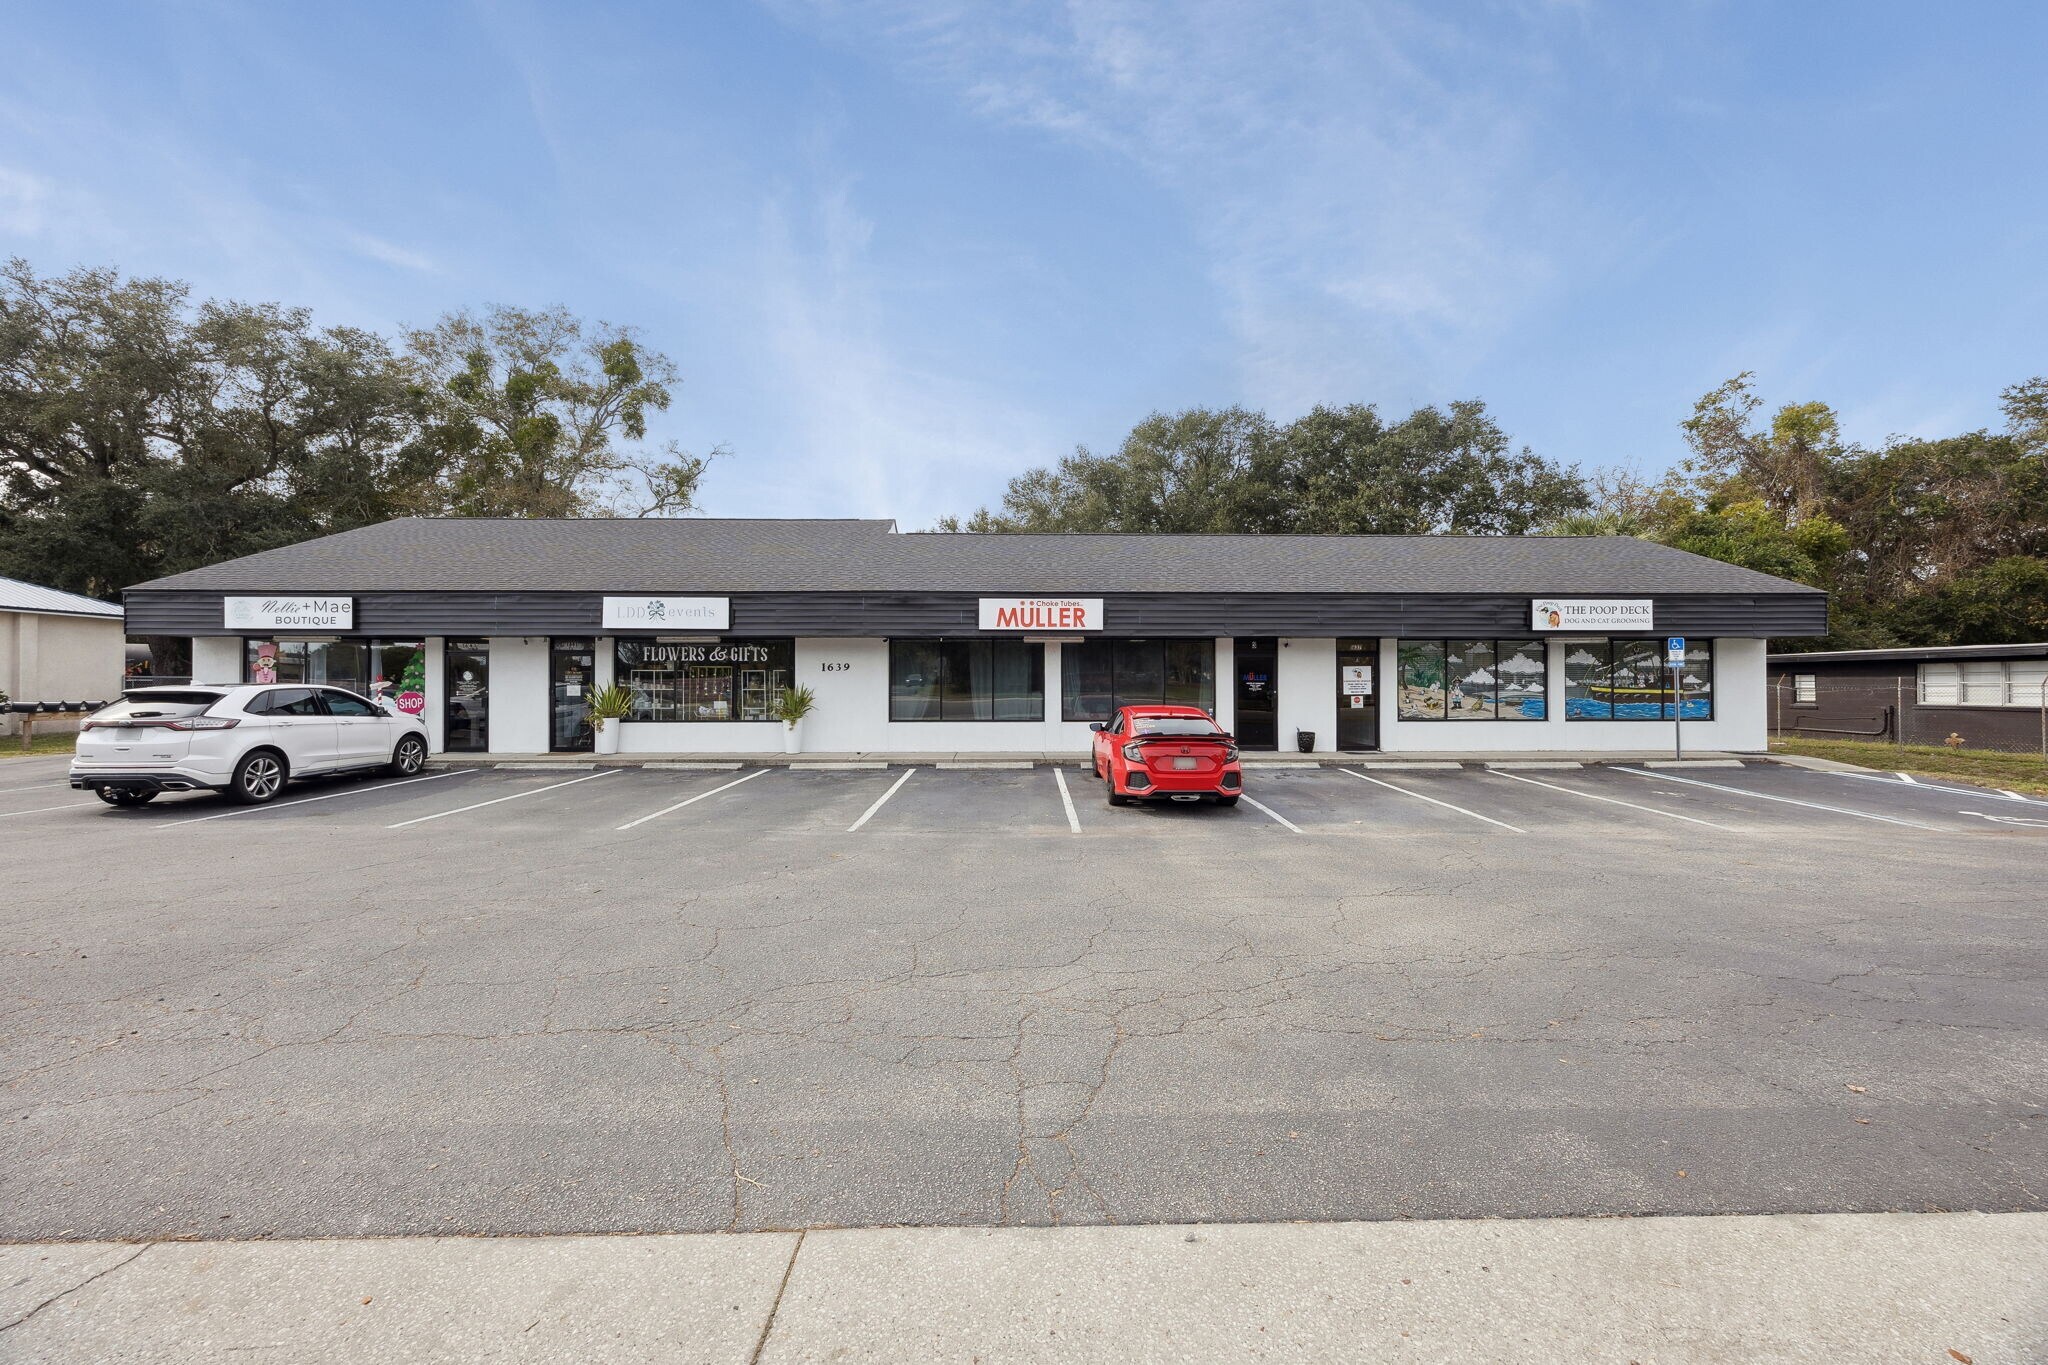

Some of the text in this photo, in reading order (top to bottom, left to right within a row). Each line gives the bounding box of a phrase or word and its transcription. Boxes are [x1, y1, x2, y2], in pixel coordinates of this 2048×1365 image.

[261, 600, 301, 613] Nellie
[314, 600, 351, 613] Mae
[668, 606, 716, 617] events
[1564, 605, 1587, 615] THE
[1589, 605, 1618, 615] POOP
[1620, 605, 1650, 615] DECK
[996, 601, 1086, 628] MÜLLER
[275, 616, 337, 625] BOUTIQUE
[643, 646, 768, 662] FLOWERS & GIFTS
[821, 662, 851, 672] 1639
[399, 697, 424, 709] SHOP
